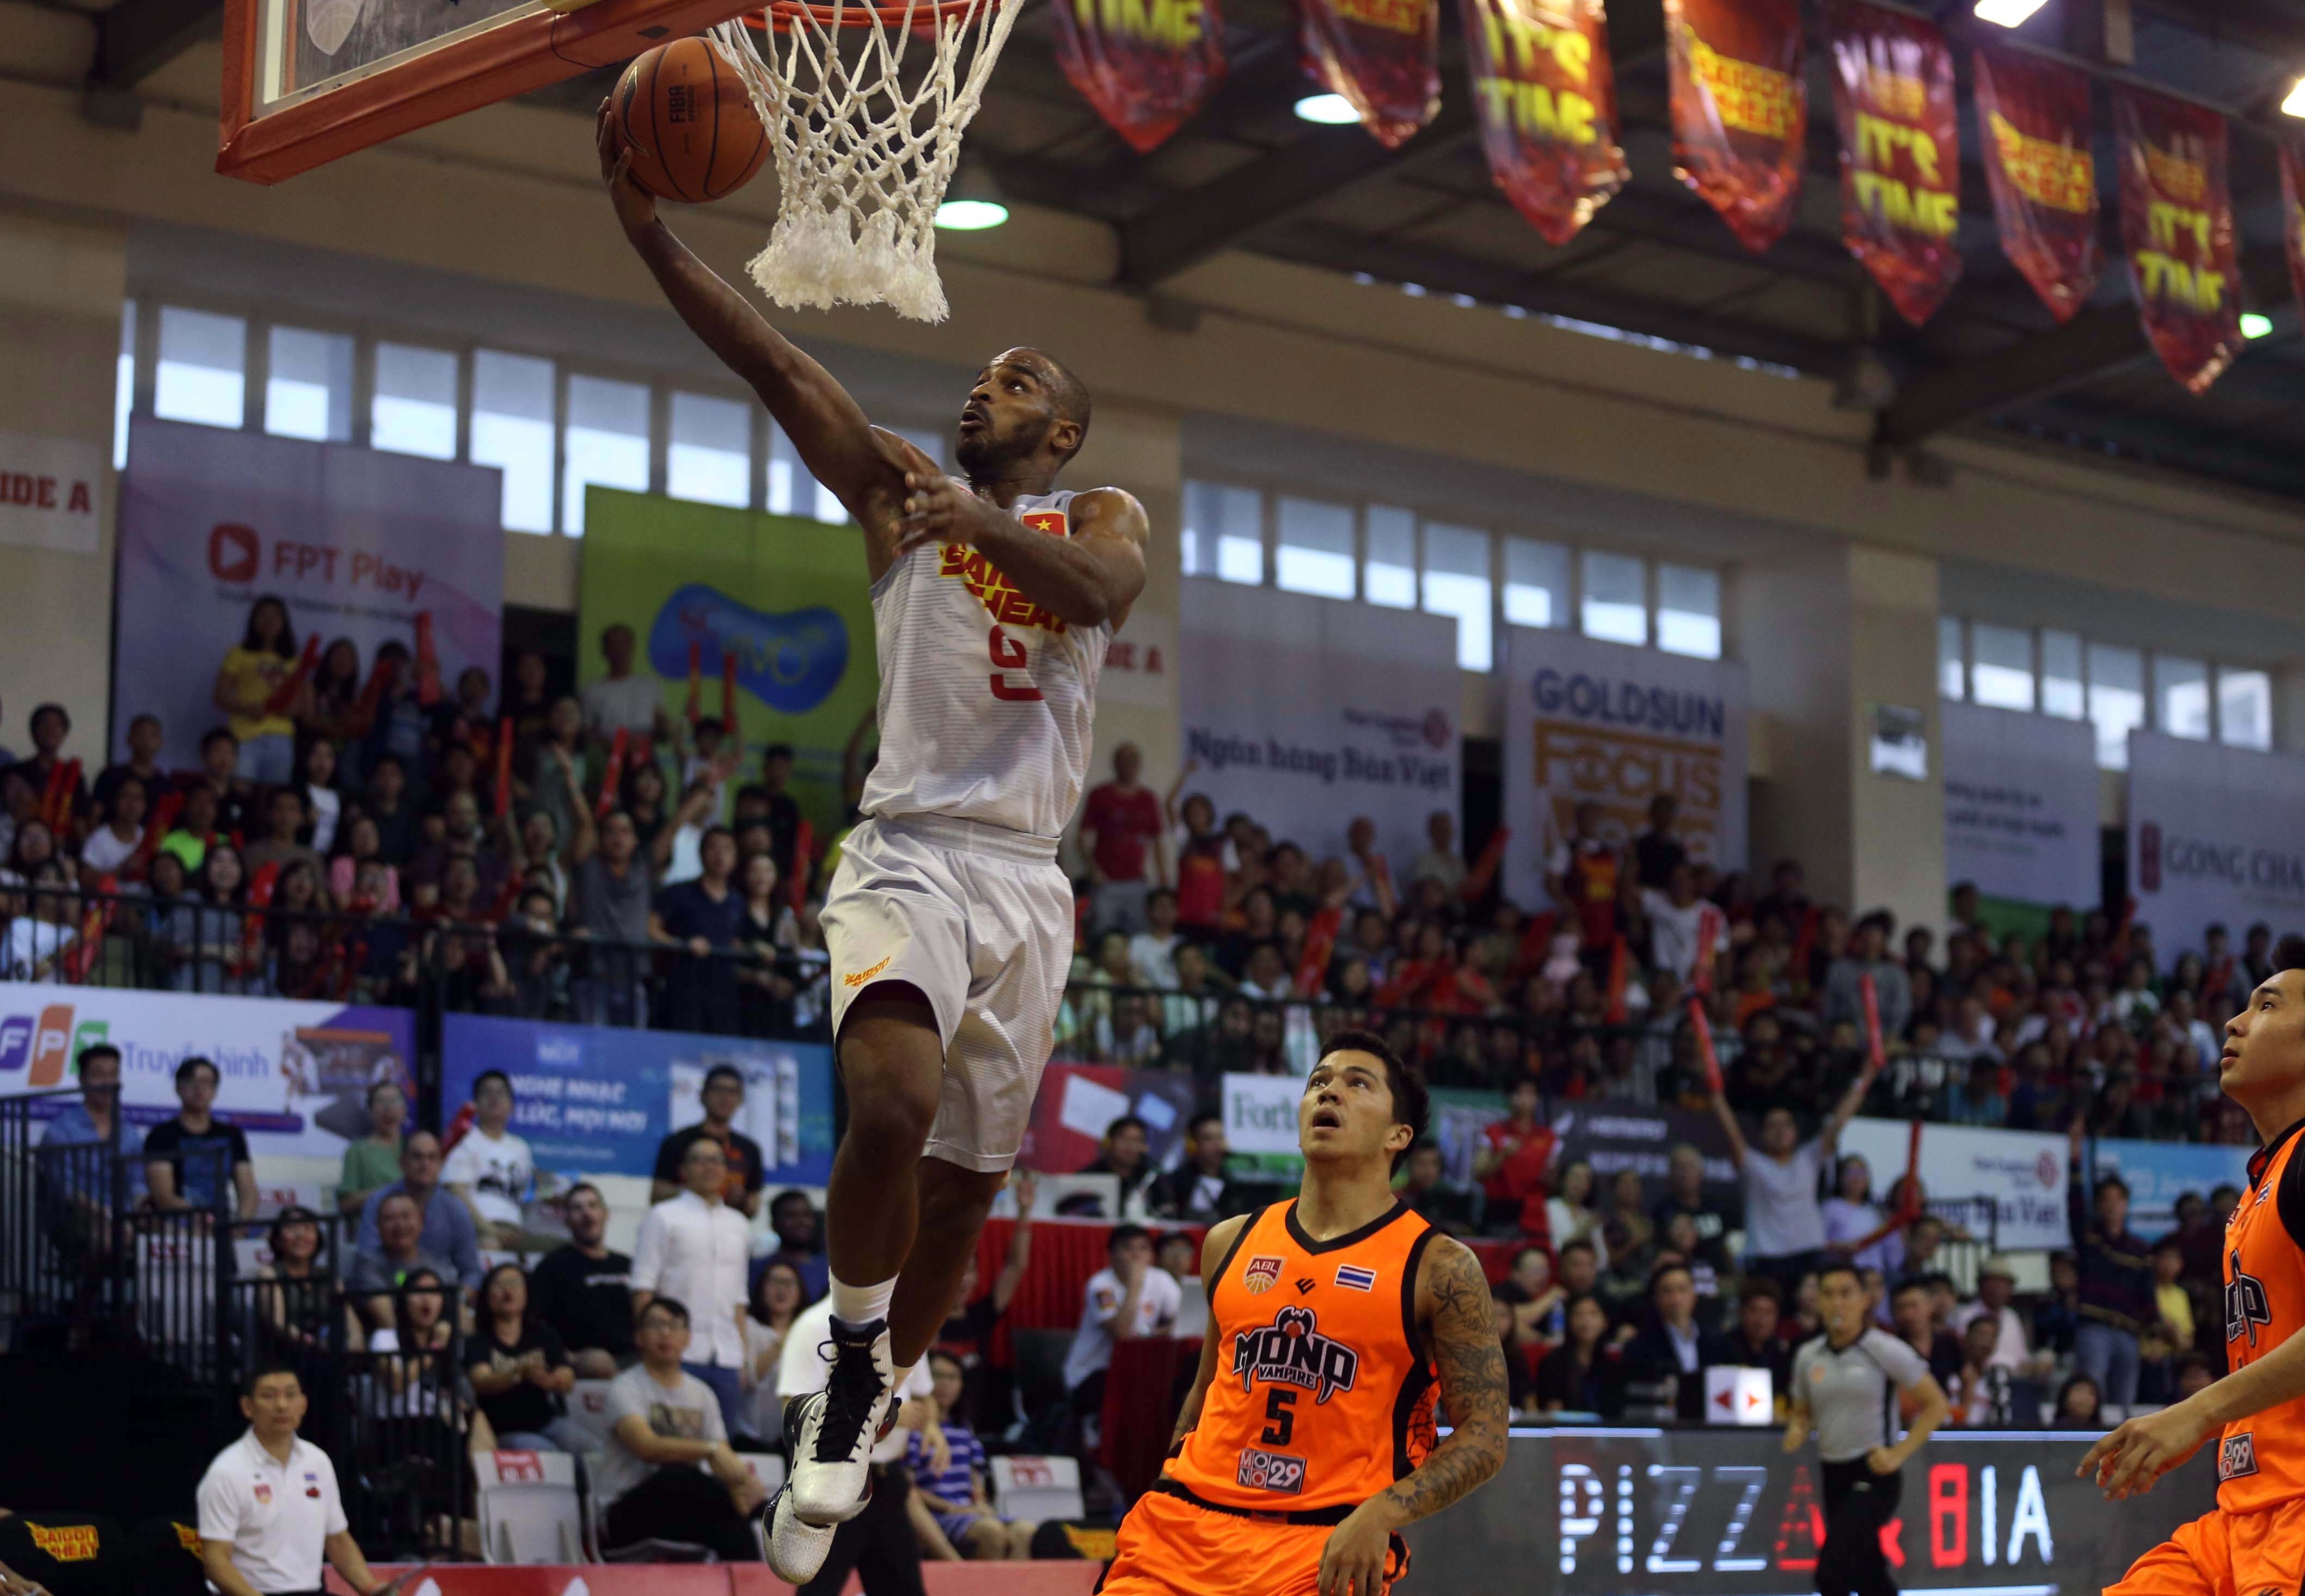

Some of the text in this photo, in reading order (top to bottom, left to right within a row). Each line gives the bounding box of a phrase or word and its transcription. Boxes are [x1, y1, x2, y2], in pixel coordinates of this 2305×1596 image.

[669, 85, 686, 123] FIBA
[1853, 170, 1959, 237] TIME
[0, 472, 93, 514] IDE A
[274, 541, 426, 602] FPT Play
[1533, 667, 1725, 737] GOLDSUN
[2165, 835, 2246, 884] GONG
[1234, 1092, 1300, 1131] Forb
[1250, 1260, 1278, 1274] ABL
[1233, 1326, 1359, 1404] MONO
[1259, 1365, 1316, 1387] VAMPIRE
[1260, 1388, 1297, 1447] 5
[1267, 1460, 1301, 1488] 29
[2233, 1441, 2250, 1470] 29
[1560, 1463, 1827, 1575] PIZZA
